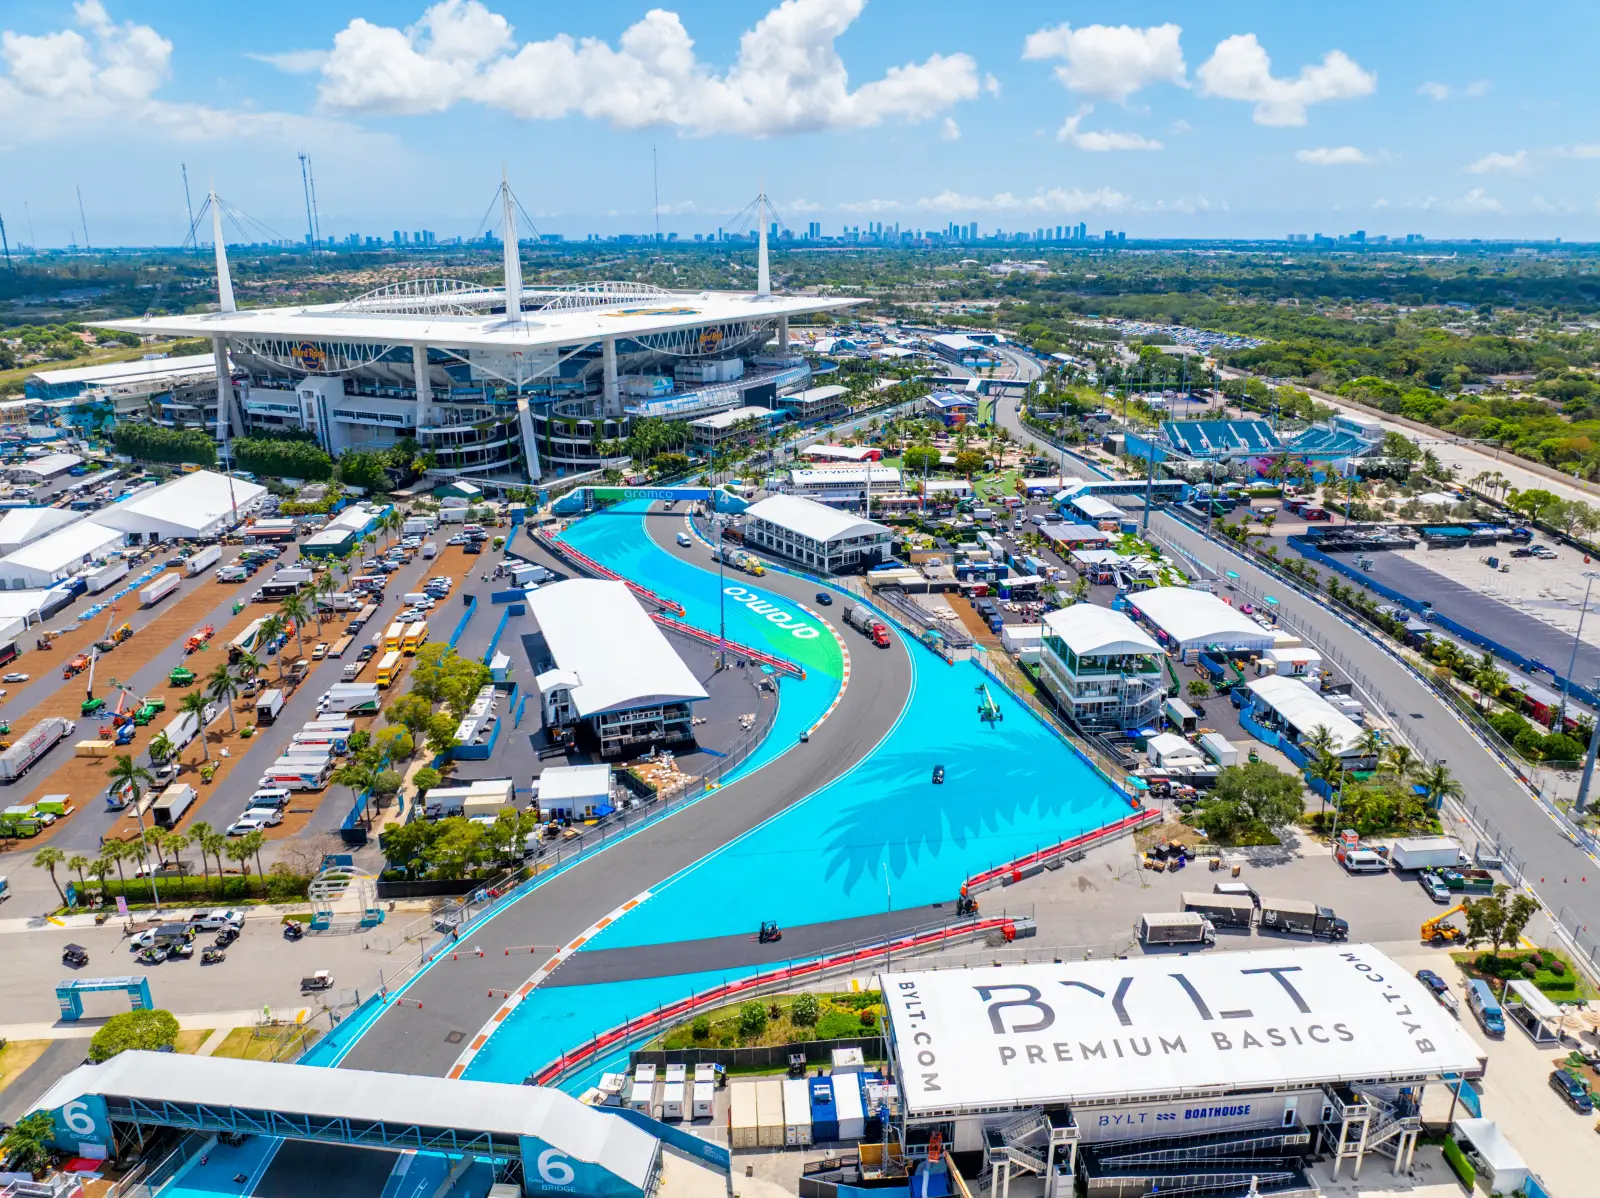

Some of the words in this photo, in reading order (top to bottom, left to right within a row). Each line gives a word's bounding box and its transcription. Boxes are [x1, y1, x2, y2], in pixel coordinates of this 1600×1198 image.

[573, 489, 583, 501] 4
[624, 489, 673, 499] aramco
[719, 492, 730, 505] 4
[723, 586, 820, 639] aramco
[971, 964, 1312, 1035] BYLT
[1339, 952, 1437, 1054] BYLT.COM
[898, 981, 942, 1092] BYLT.COM
[998, 1034, 1188, 1066] PREMIUM
[1211, 1022, 1354, 1051] BASICS
[62, 1100, 96, 1135] 6
[1099, 1112, 1148, 1126] BYLT
[1184, 1104, 1251, 1120] BOATHOUSE
[70, 1133, 100, 1142] BRIDGE
[537, 1148, 575, 1186] 6
[541, 1184, 577, 1193] BRIDGE
